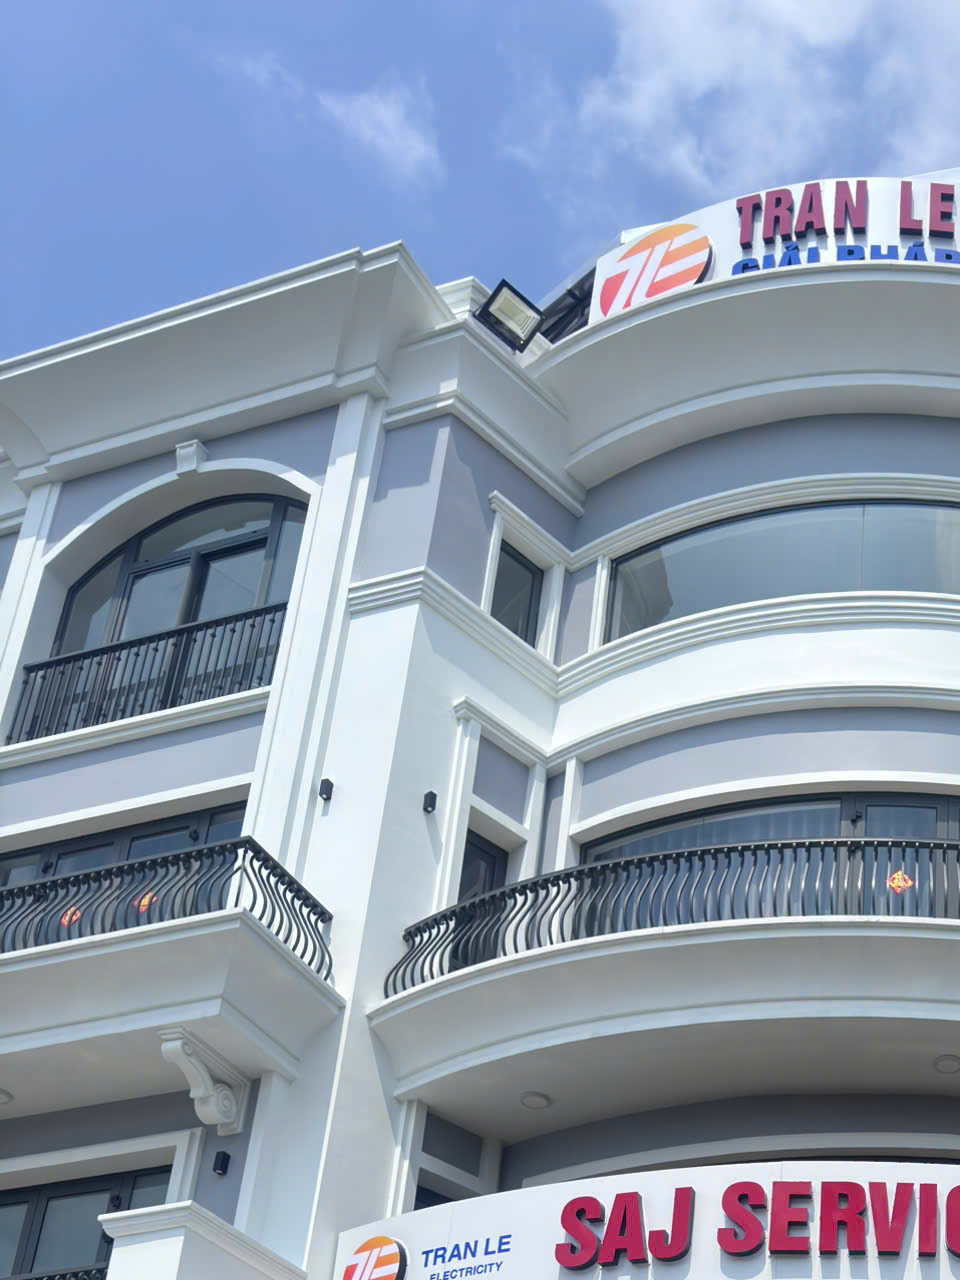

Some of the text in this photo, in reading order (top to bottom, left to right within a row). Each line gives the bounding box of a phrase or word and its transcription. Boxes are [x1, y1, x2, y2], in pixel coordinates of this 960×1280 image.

[736, 180, 868, 249] TRAN
[899, 181, 955, 239] LE
[422, 1234, 512, 1268] TRAN LE
[554, 1187, 694, 1271] SAJ
